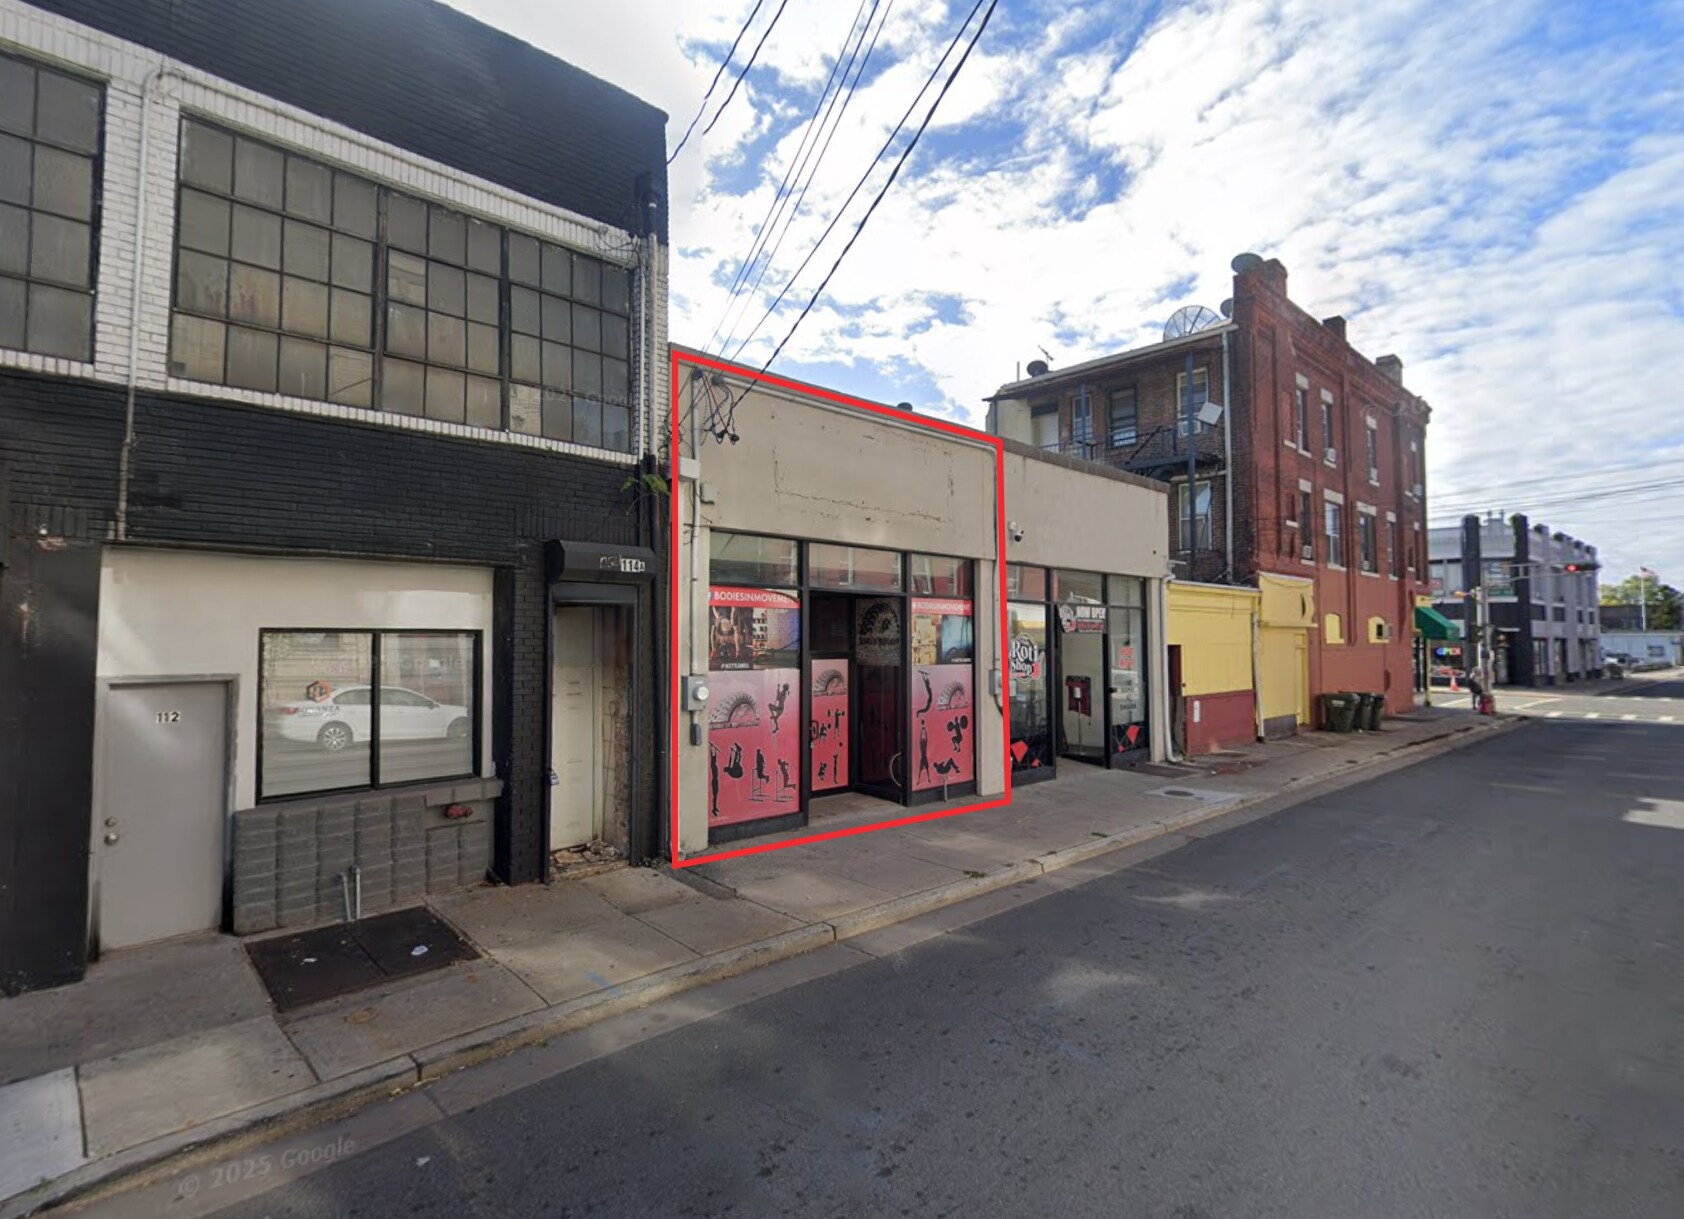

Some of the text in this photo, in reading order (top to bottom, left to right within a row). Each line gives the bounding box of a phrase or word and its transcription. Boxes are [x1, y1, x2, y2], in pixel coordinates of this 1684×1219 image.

[714, 591, 796, 604] BODIESINMOVEME
[1009, 640, 1038, 662] Roti
[157, 711, 179, 722] 112
